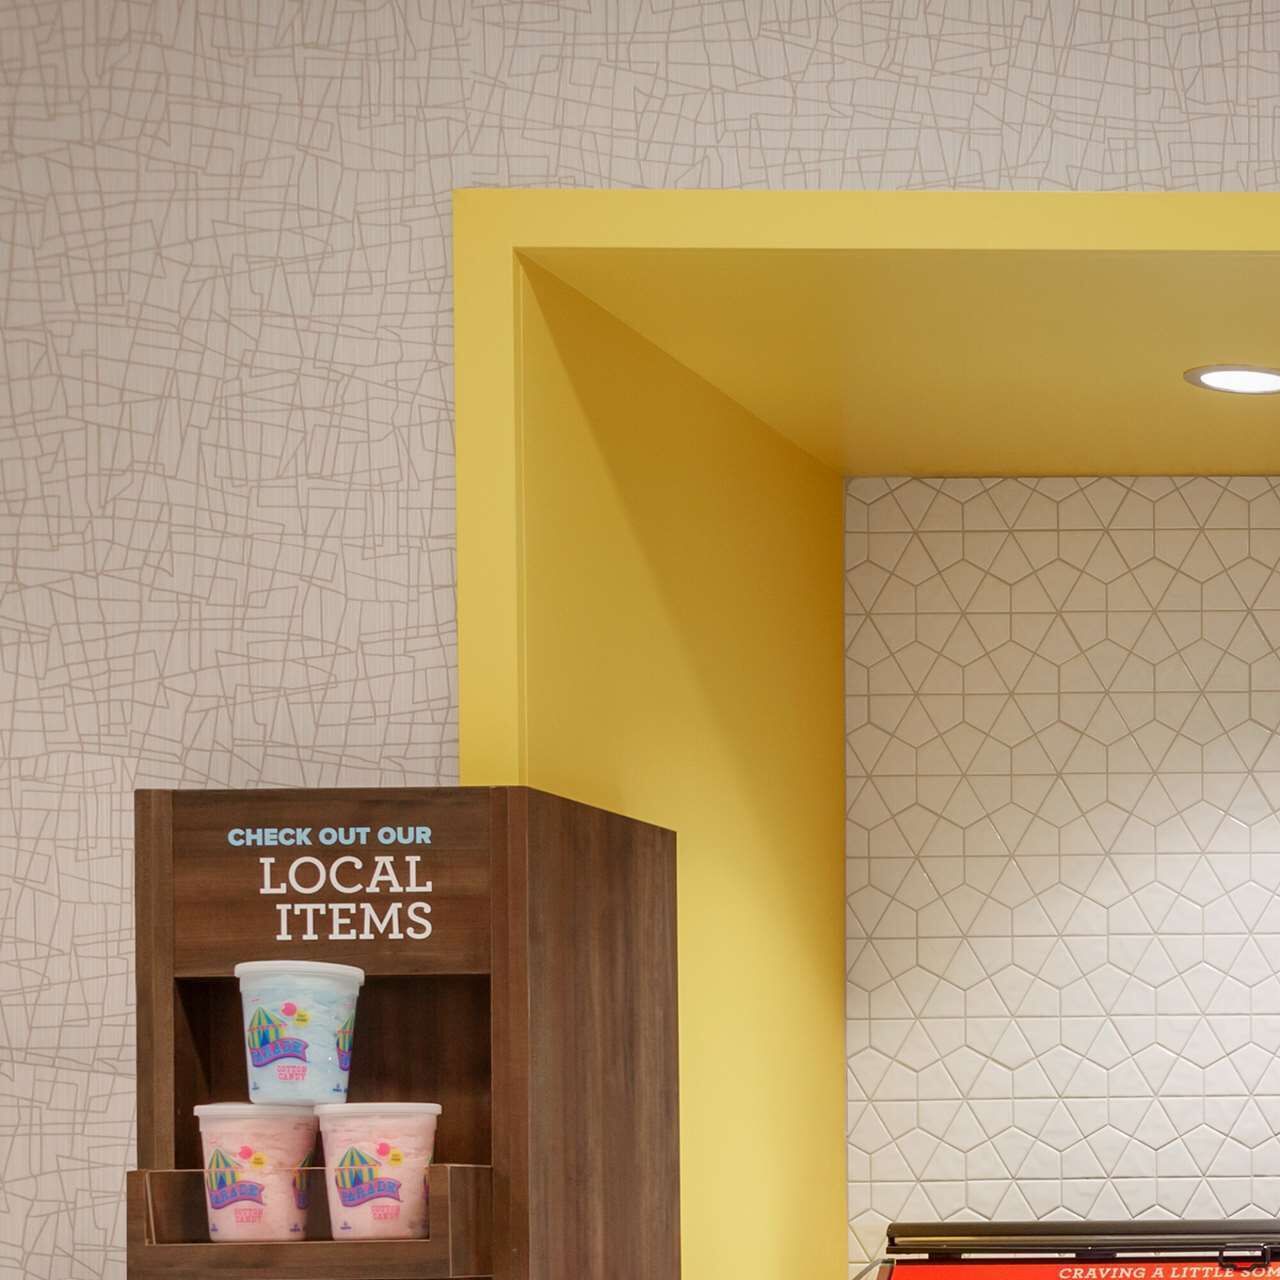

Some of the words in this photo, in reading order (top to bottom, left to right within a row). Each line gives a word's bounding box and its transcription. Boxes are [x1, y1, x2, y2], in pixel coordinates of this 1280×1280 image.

[227, 827, 312, 847] CHECK
[318, 826, 371, 846] OUT
[377, 826, 432, 845] OUR
[259, 855, 433, 895] LOCAL
[275, 902, 433, 941] ITEMS
[1058, 1266, 1146, 1280] CRAVING
[1151, 1266, 1165, 1279] A
[1170, 1266, 1235, 1279] LITTLE
